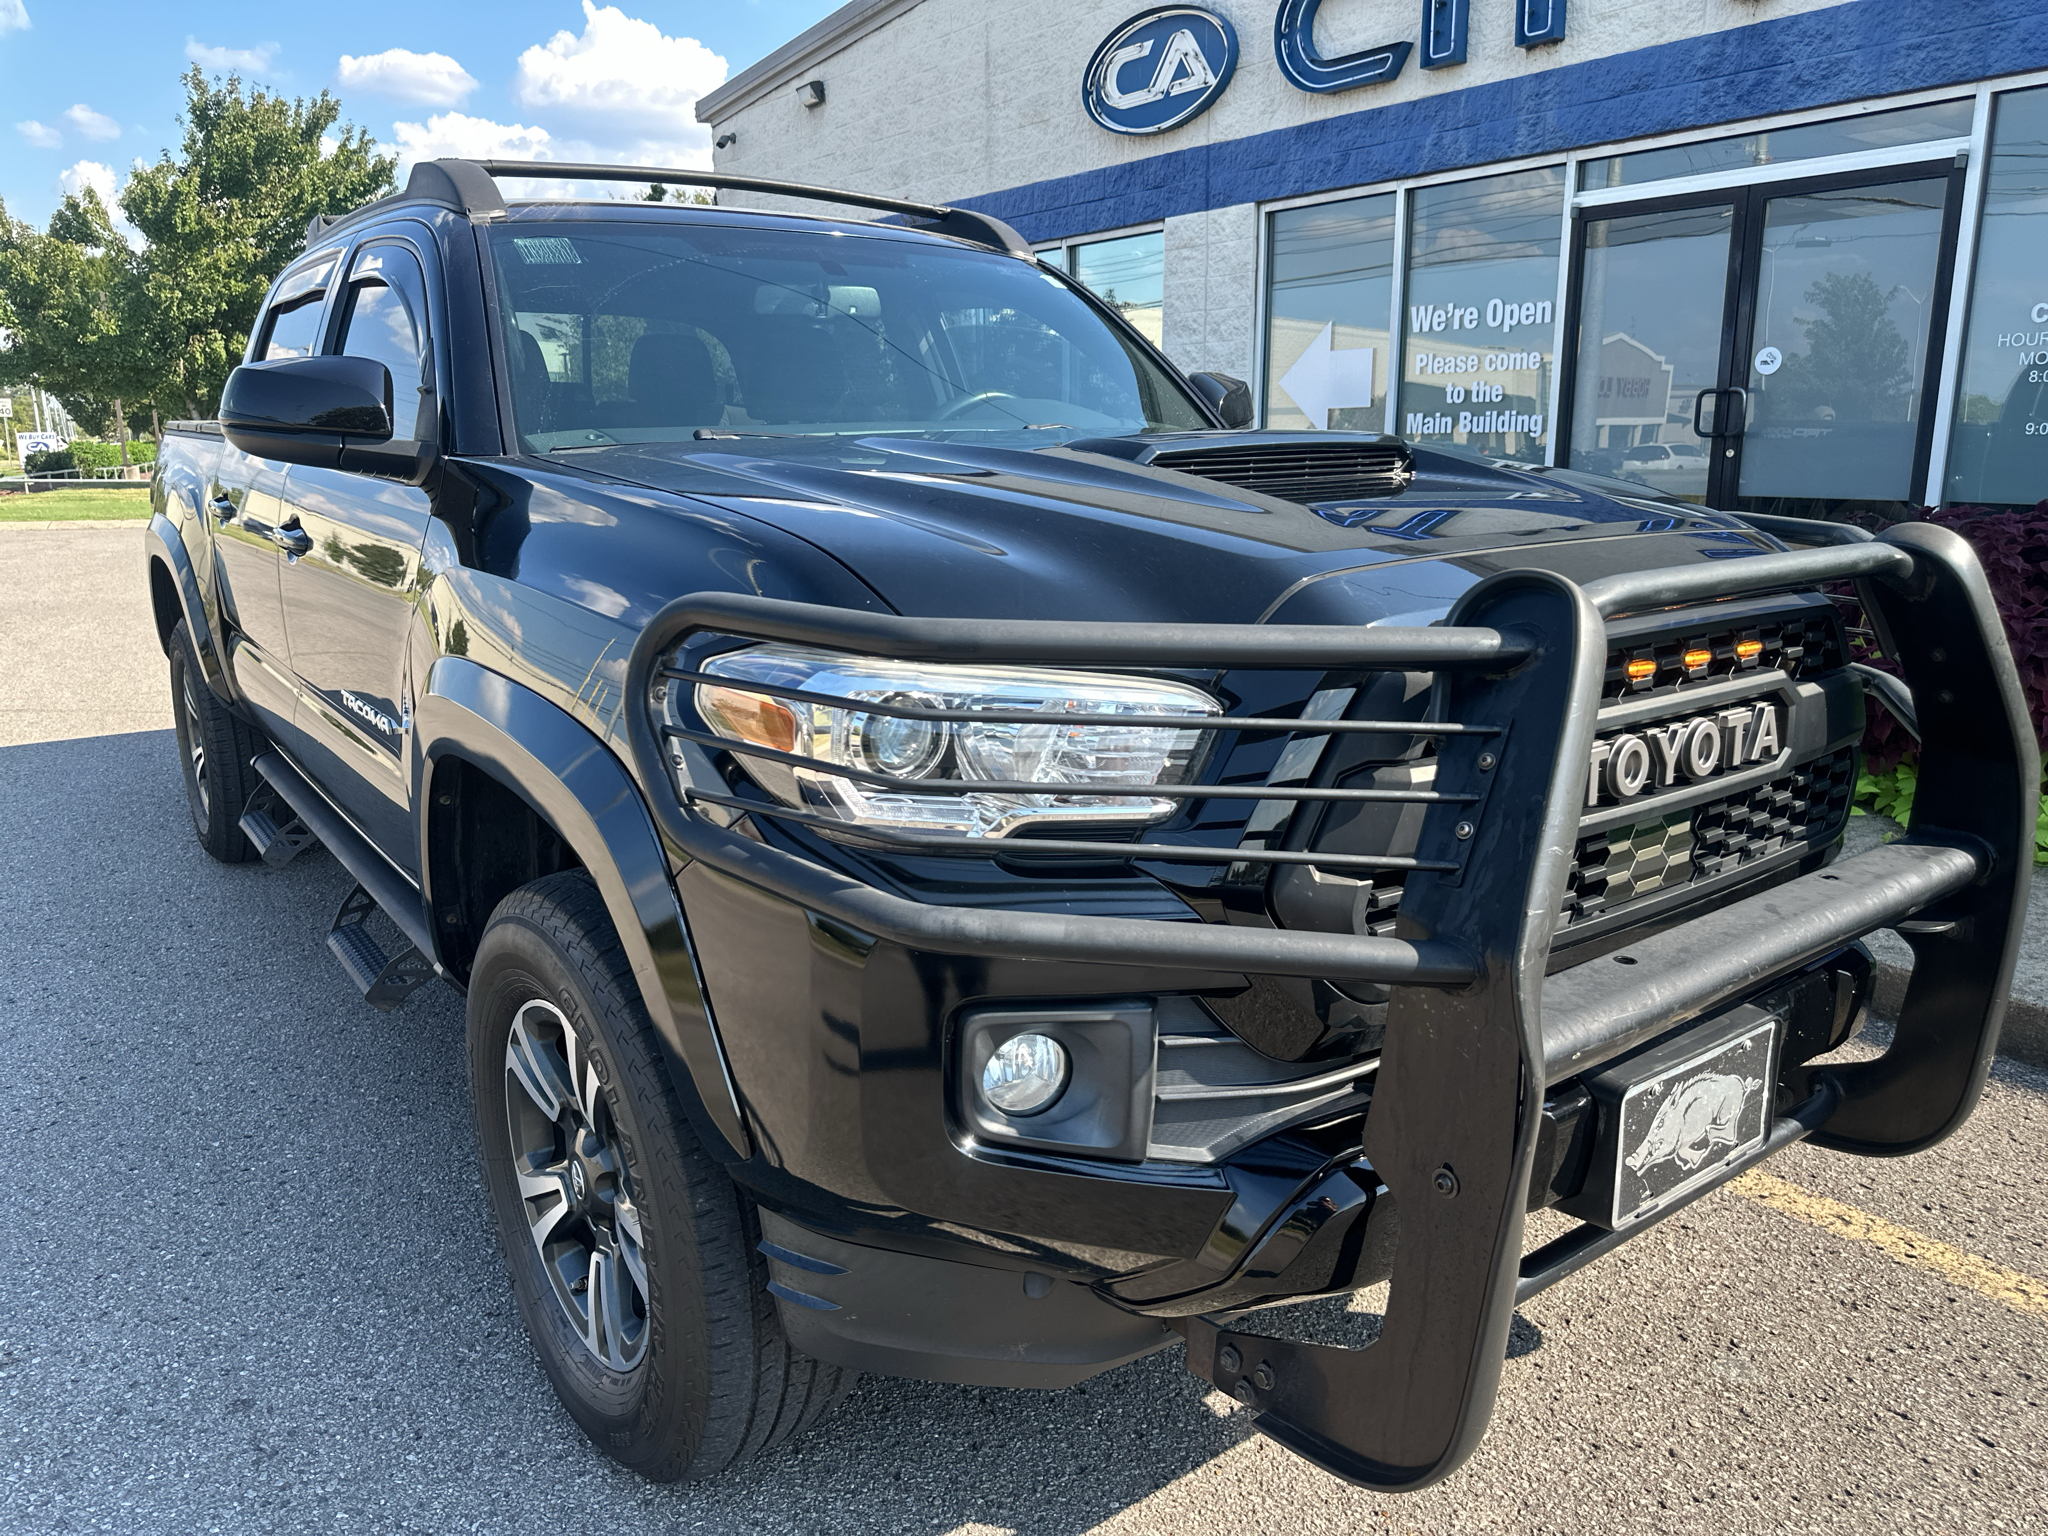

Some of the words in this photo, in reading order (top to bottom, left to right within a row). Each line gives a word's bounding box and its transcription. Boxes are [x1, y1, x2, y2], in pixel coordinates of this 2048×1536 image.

[1100, 28, 1216, 110] CA
[1411, 302, 1479, 333] We're
[1486, 298, 1552, 333] Open
[1415, 353, 1478, 375] Please
[1484, 351, 1541, 372] come
[1445, 382, 1465, 404] to
[1471, 380, 1503, 403] the
[1406, 412, 1453, 435] Main
[1458, 410, 1543, 438] Building
[341, 689, 391, 736] TACOMA
[1586, 701, 1779, 807] TOYOTA
